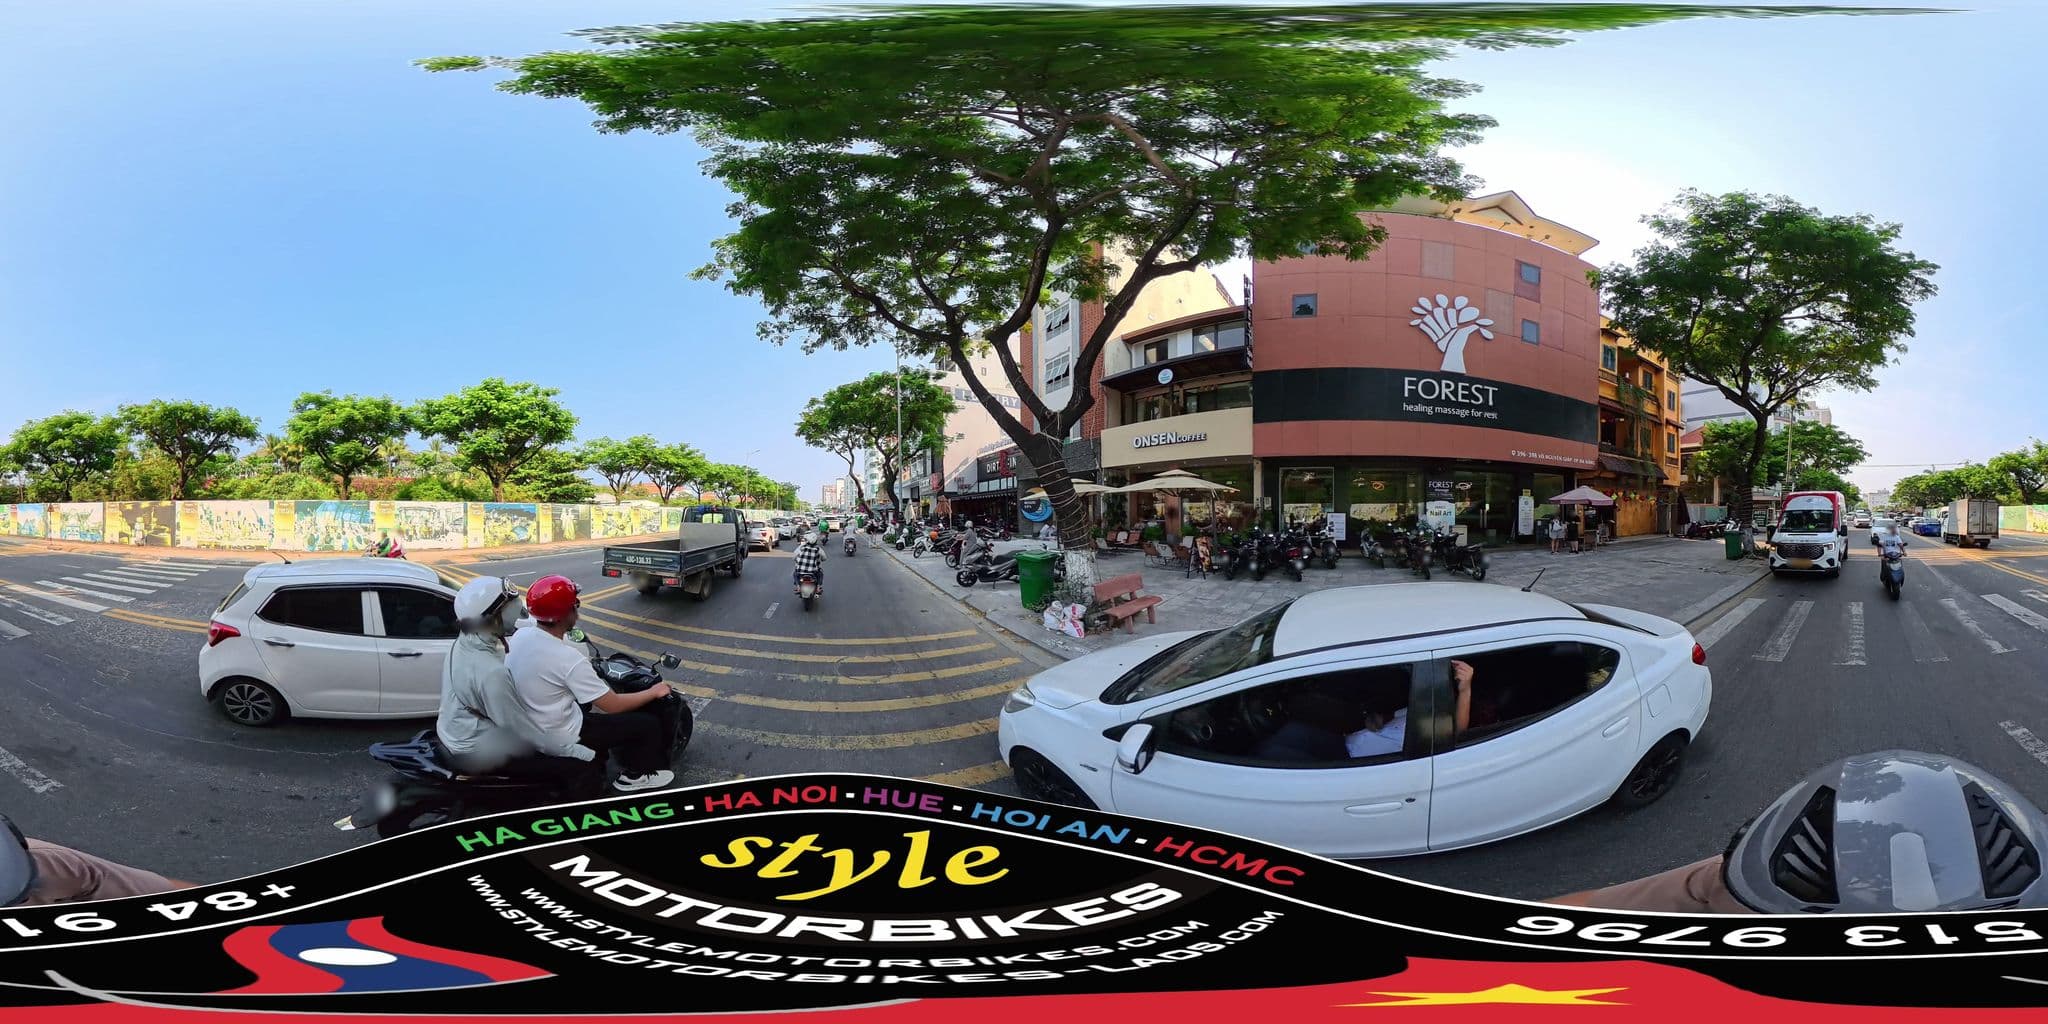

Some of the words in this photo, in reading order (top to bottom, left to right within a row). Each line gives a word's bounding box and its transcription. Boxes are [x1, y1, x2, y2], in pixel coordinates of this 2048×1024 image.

[1403, 377, 1499, 406] FOREST
[1403, 402, 1434, 416] healing
[1434, 405, 1470, 417] massage
[1471, 407, 1484, 417] for
[1133, 432, 1178, 450] ONSEN
[1177, 432, 1207, 444] COFFEE
[1428, 481, 1453, 489] FOREST
[1430, 510, 1442, 521] Nail
[1442, 510, 1452, 521] Art
